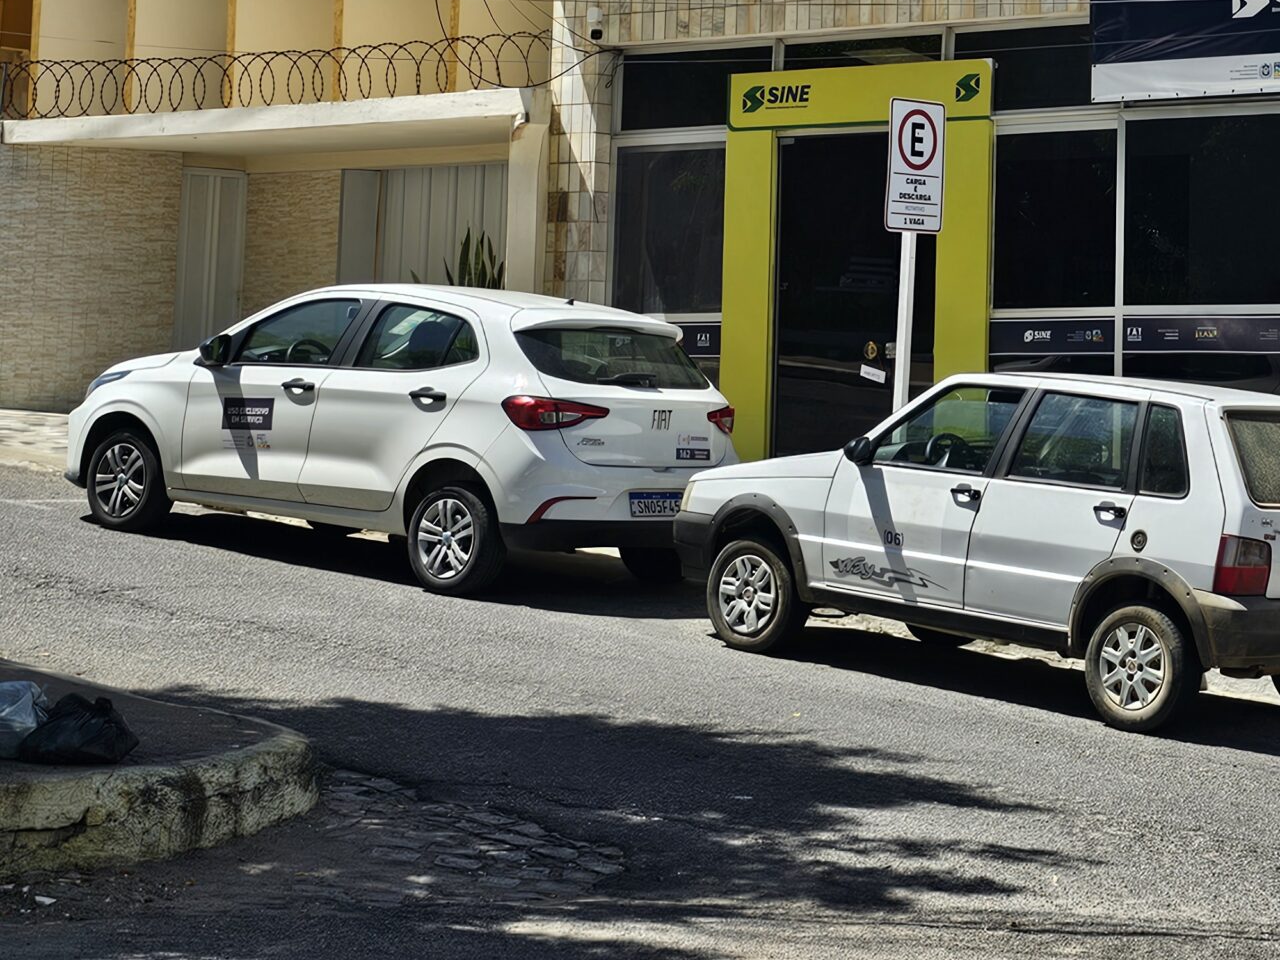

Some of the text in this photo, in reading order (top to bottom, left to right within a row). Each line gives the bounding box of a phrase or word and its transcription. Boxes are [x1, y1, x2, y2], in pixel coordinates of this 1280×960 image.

[767, 85, 812, 104] SINE
[910, 122, 925, 158] E
[905, 177, 926, 186] CARGA
[899, 192, 931, 201] DESCARGA
[651, 409, 673, 431] FIAT
[837, 556, 876, 580] Way
